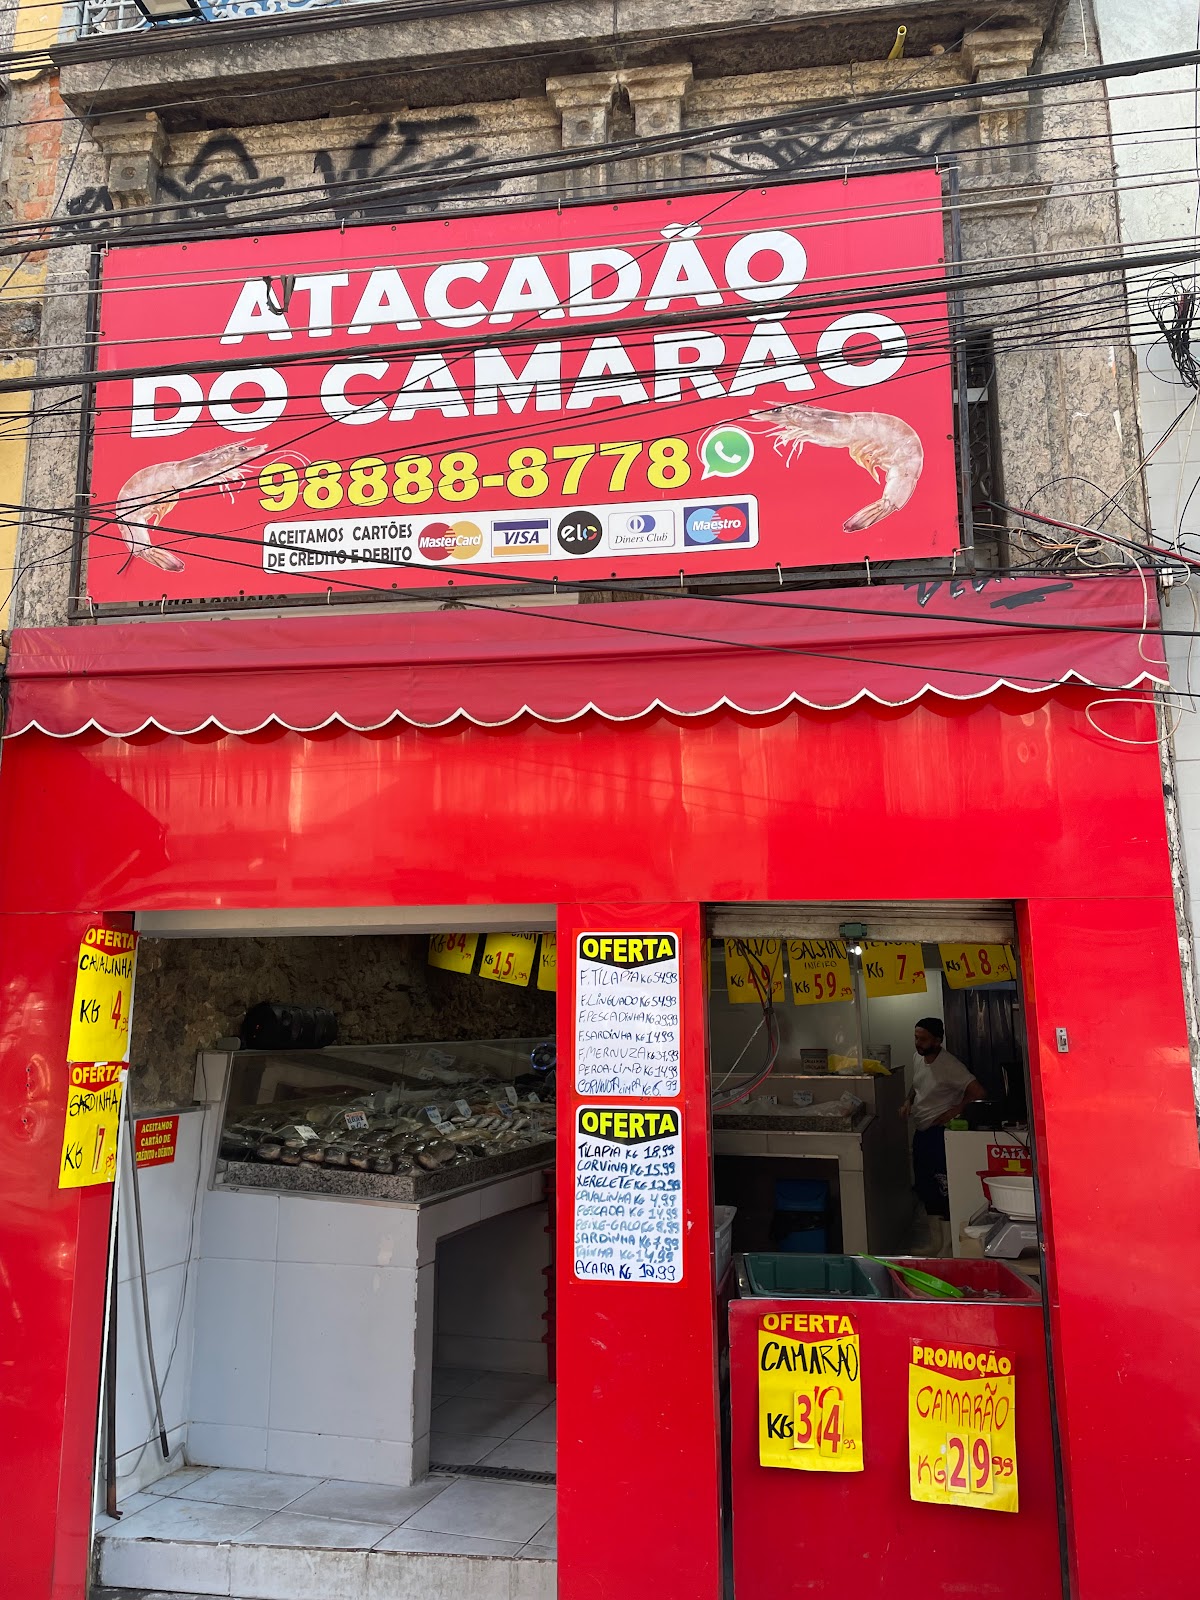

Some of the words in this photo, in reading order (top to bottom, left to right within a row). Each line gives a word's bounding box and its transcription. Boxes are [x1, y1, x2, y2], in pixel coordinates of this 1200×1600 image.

[219, 221, 808, 344] ATACADÃO
[130, 364, 288, 438] DO
[320, 306, 908, 425] CAMARÃO
[258, 438, 691, 512] 98888-8778
[269, 527, 344, 546] ACEITAMOS
[352, 521, 413, 541] CARTÕES
[560, 524, 598, 542] elo
[692, 518, 742, 532] Maestro
[419, 534, 481, 548] MasterCard
[503, 530, 540, 545] VISA
[614, 533, 644, 545] Diners
[646, 532, 668, 543] Club
[267, 552, 285, 568] DE
[84, 928, 136, 950] OFERTA
[582, 939, 674, 963] OFERTA
[79, 954, 133, 979] CAVALINHA
[72, 1065, 122, 1085] OFERTA
[69, 1089, 118, 1117] SARDINHA
[141, 1121, 173, 1134] ACEITAMOS
[581, 1111, 676, 1139] OFERTA
[140, 1134, 163, 1147] CARTÃO
[163, 1134, 172, 1144] DE
[578, 1142, 621, 1159] TILAPIA
[625, 1149, 639, 1160] KG
[577, 1159, 628, 1174] CORVINA
[629, 1163, 644, 1176] KG
[576, 1174, 635, 1189] XERELETE
[633, 1180, 648, 1190] KG
[575, 1190, 632, 1205] CAVALINHA
[574, 1231, 636, 1246] SARDINHA
[618, 1263, 633, 1280] KG
[762, 1313, 855, 1335] OFERTA
[760, 1338, 859, 1382] CAMARÃO
[912, 1345, 1012, 1377] PROMOÇÃO
[916, 1382, 1010, 1433] CAMARÃO
